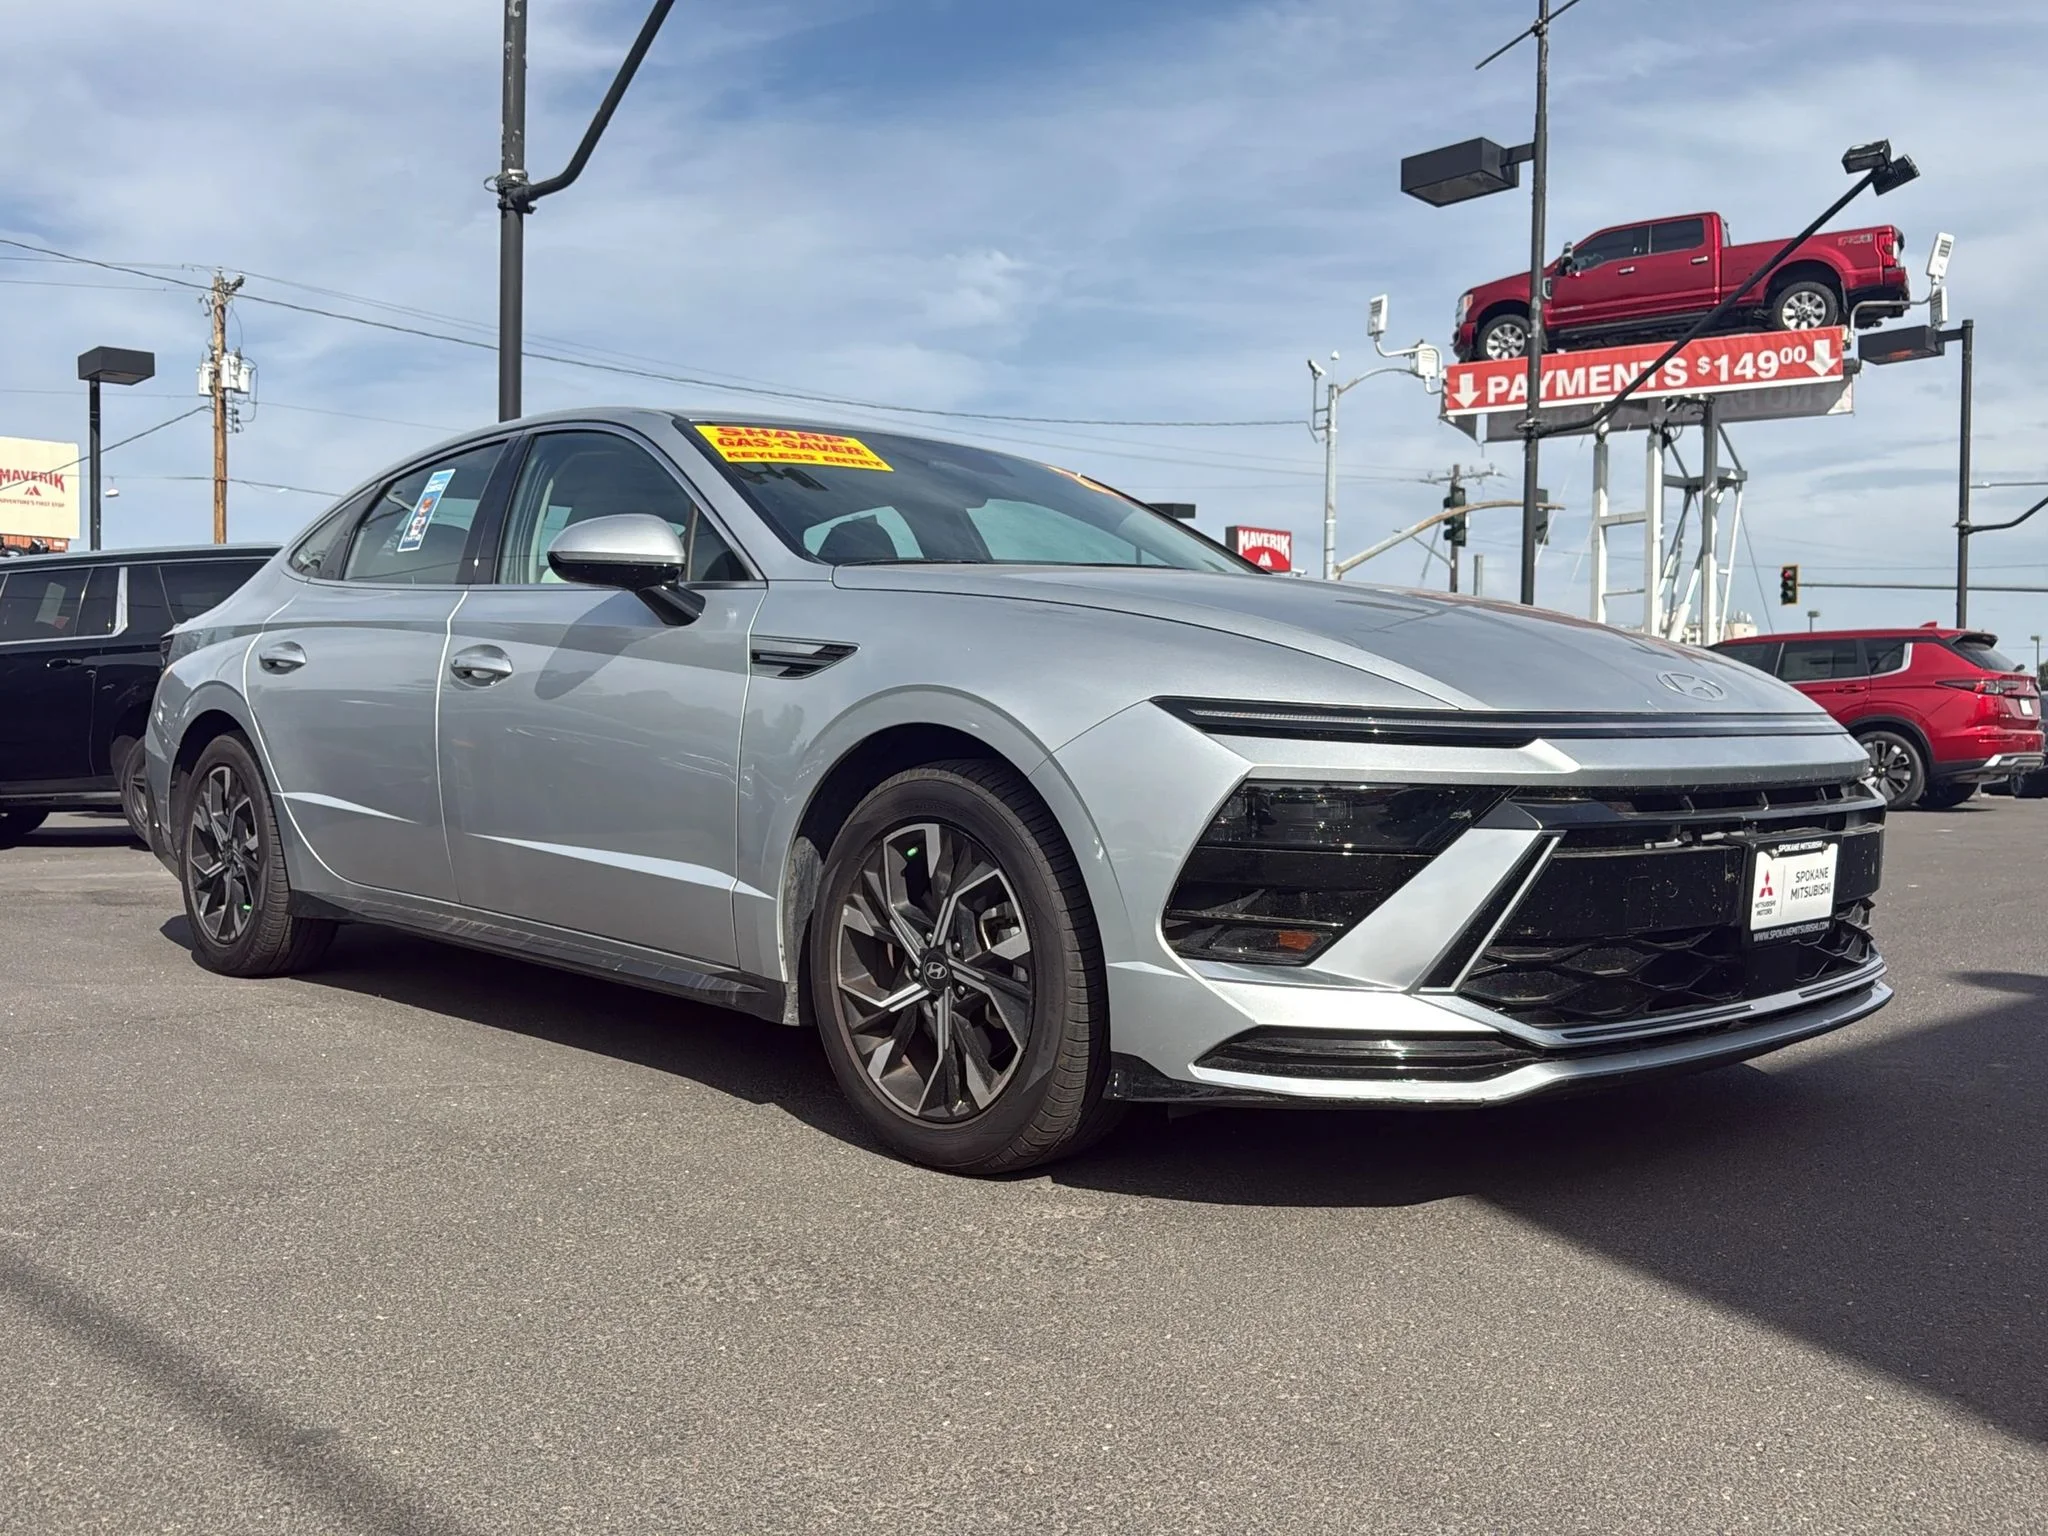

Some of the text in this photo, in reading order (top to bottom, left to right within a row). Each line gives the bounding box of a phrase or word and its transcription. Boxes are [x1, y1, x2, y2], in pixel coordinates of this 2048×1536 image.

[1487, 357, 1688, 404] PAYMENTS
[717, 427, 849, 443] SHARP
[717, 437, 868, 458] GAS-SAVER
[727, 451, 884, 467] KEYLESS ENTRY
[0, 468, 65, 493] MAVERIK
[1238, 530, 1290, 562] MAVERIK
[1795, 867, 1829, 883] SPOKANE
[1790, 882, 1831, 900] MITSUBISHI
